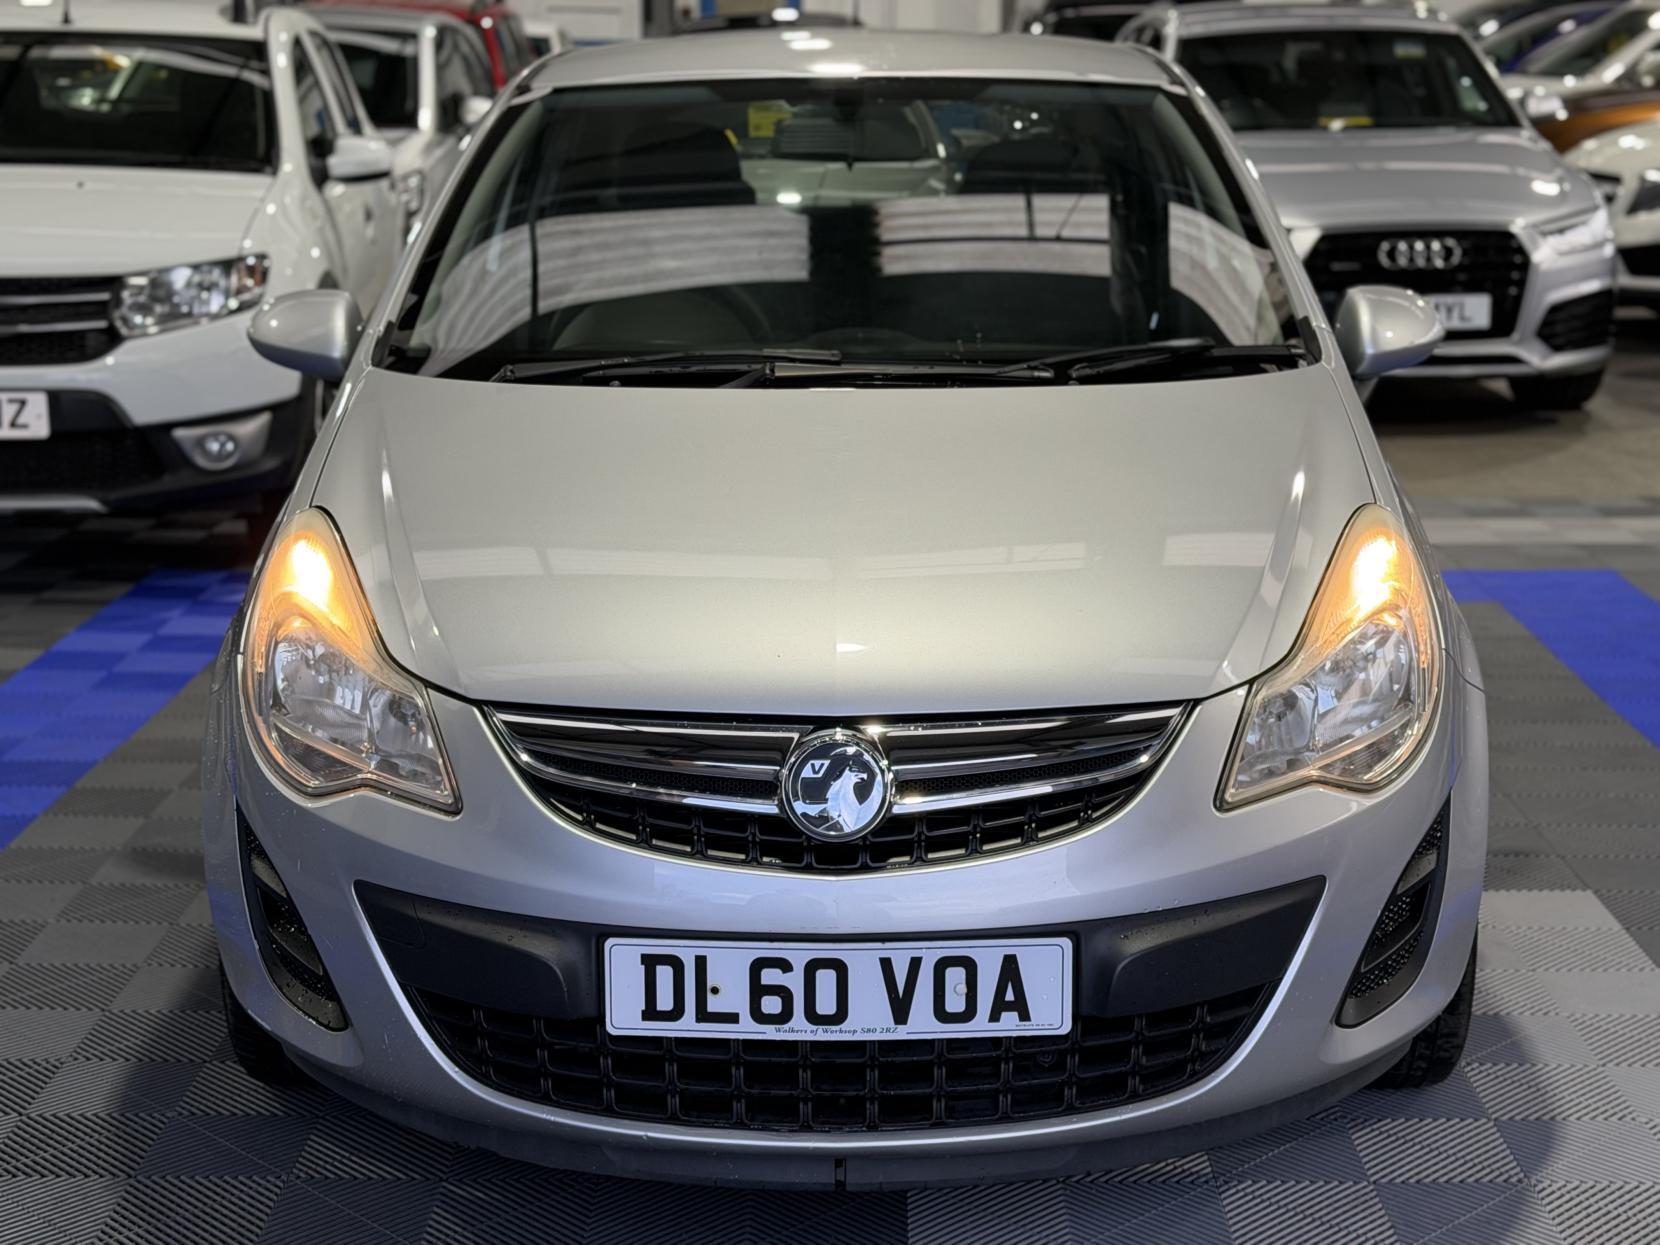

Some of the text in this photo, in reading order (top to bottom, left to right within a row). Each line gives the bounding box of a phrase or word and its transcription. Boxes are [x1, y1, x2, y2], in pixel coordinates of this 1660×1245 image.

[1434, 301, 1473, 322] YL
[640, 953, 1032, 1026] DL60 VOA
[774, 1026, 900, 1037] Walkers of Worksop S80 2RZ
